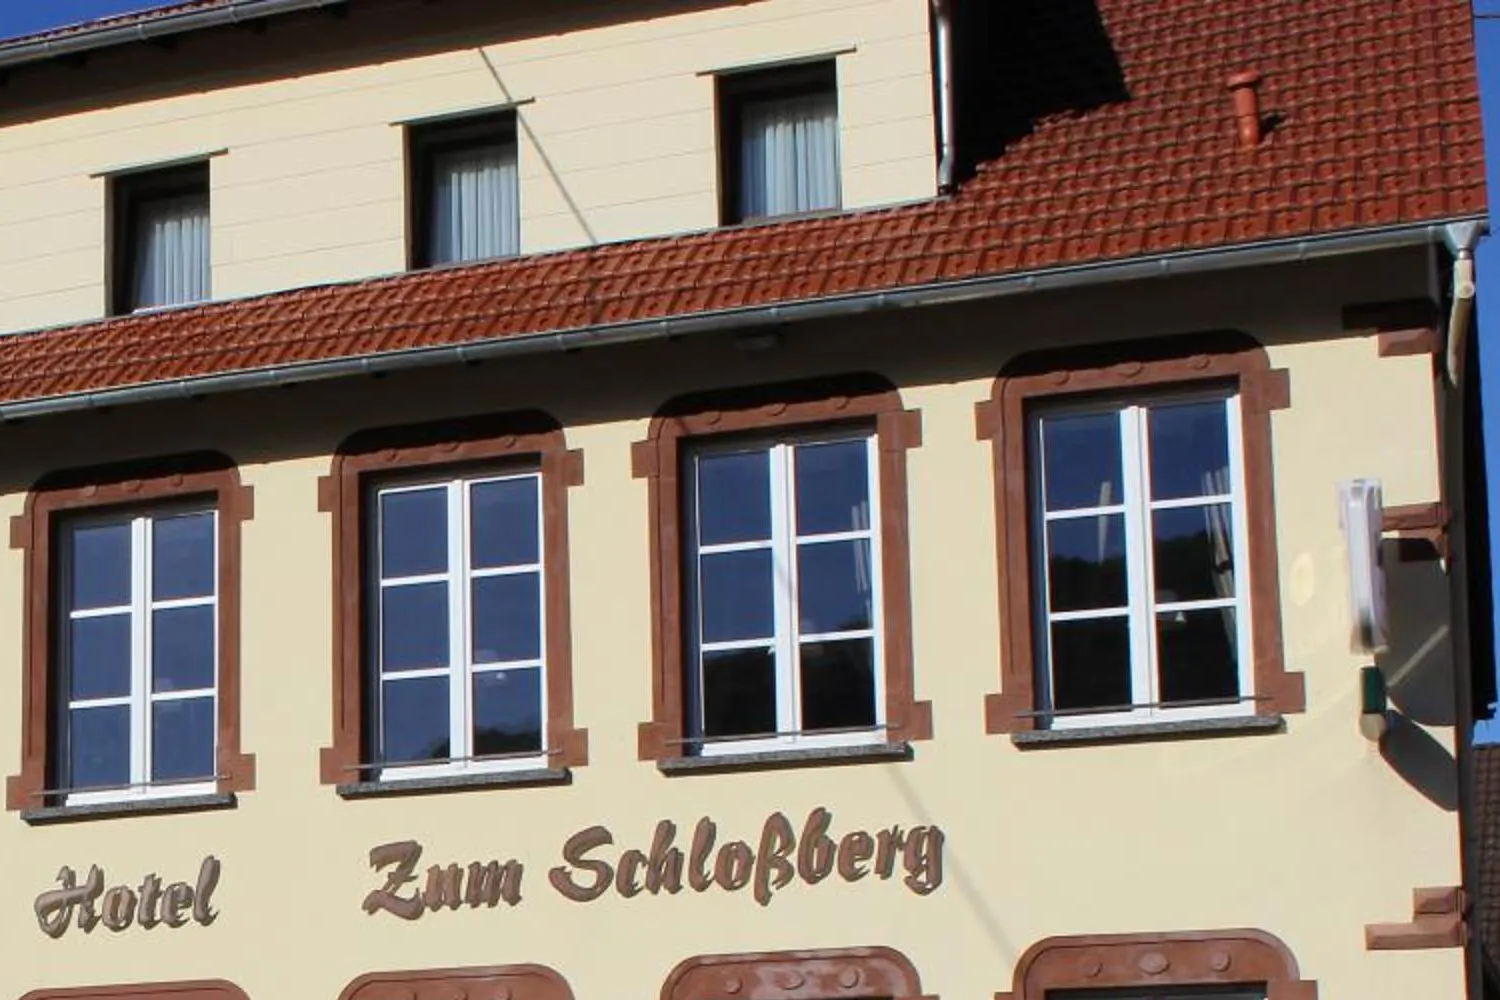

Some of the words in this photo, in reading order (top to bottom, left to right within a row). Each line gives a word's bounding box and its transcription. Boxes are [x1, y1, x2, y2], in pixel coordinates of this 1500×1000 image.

[34, 855, 221, 939] Hotel
[361, 839, 524, 921] Zum
[547, 806, 945, 906] Schloßberg
